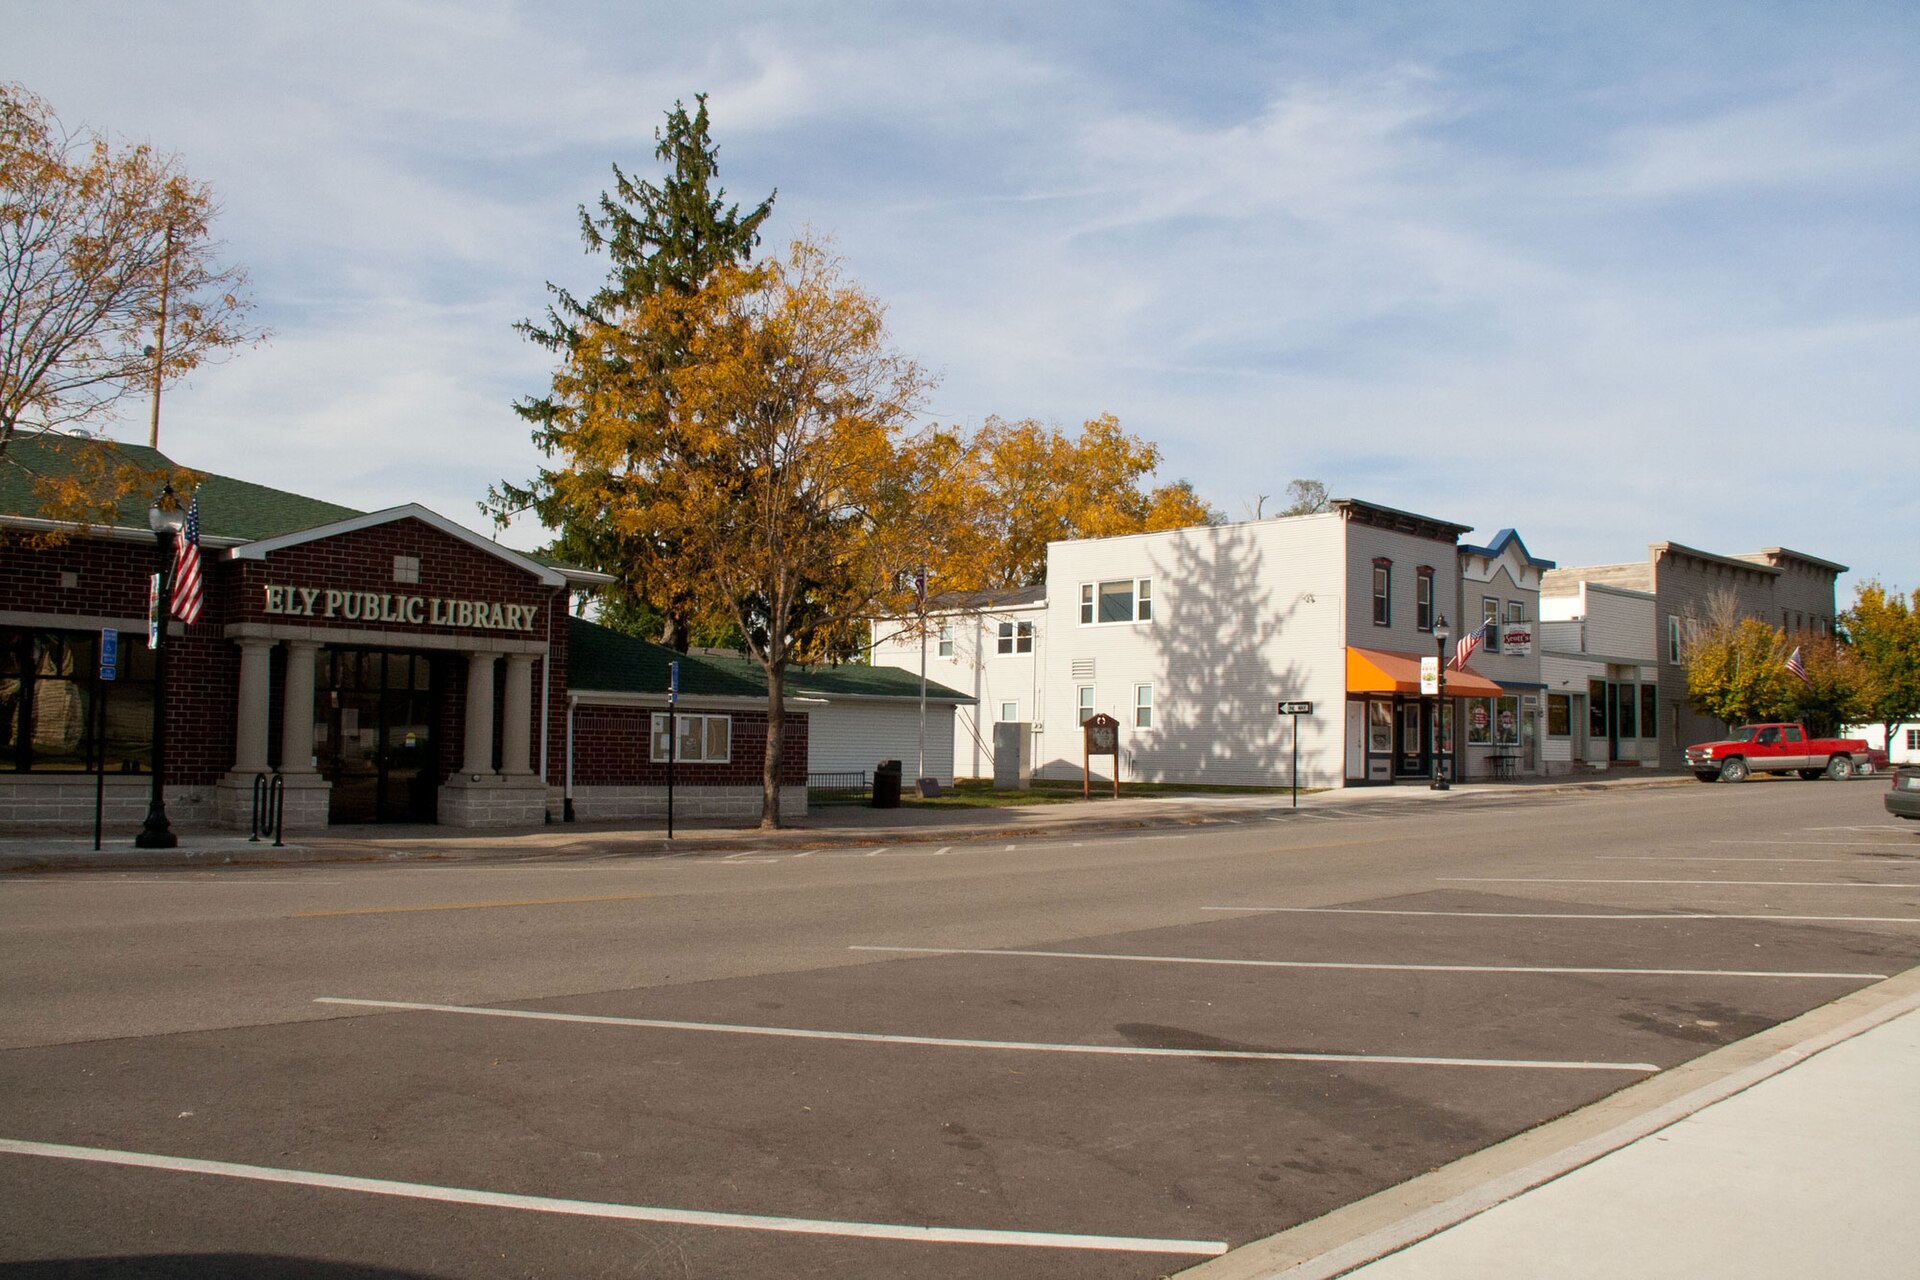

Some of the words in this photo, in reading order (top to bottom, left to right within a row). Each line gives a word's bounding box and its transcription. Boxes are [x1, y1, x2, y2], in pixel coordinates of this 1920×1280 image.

[264, 584, 321, 617] ELY
[323, 590, 424, 624] PUBLIC
[428, 598, 538, 631] LIBRARY
[1505, 633, 1529, 643] Scott's
